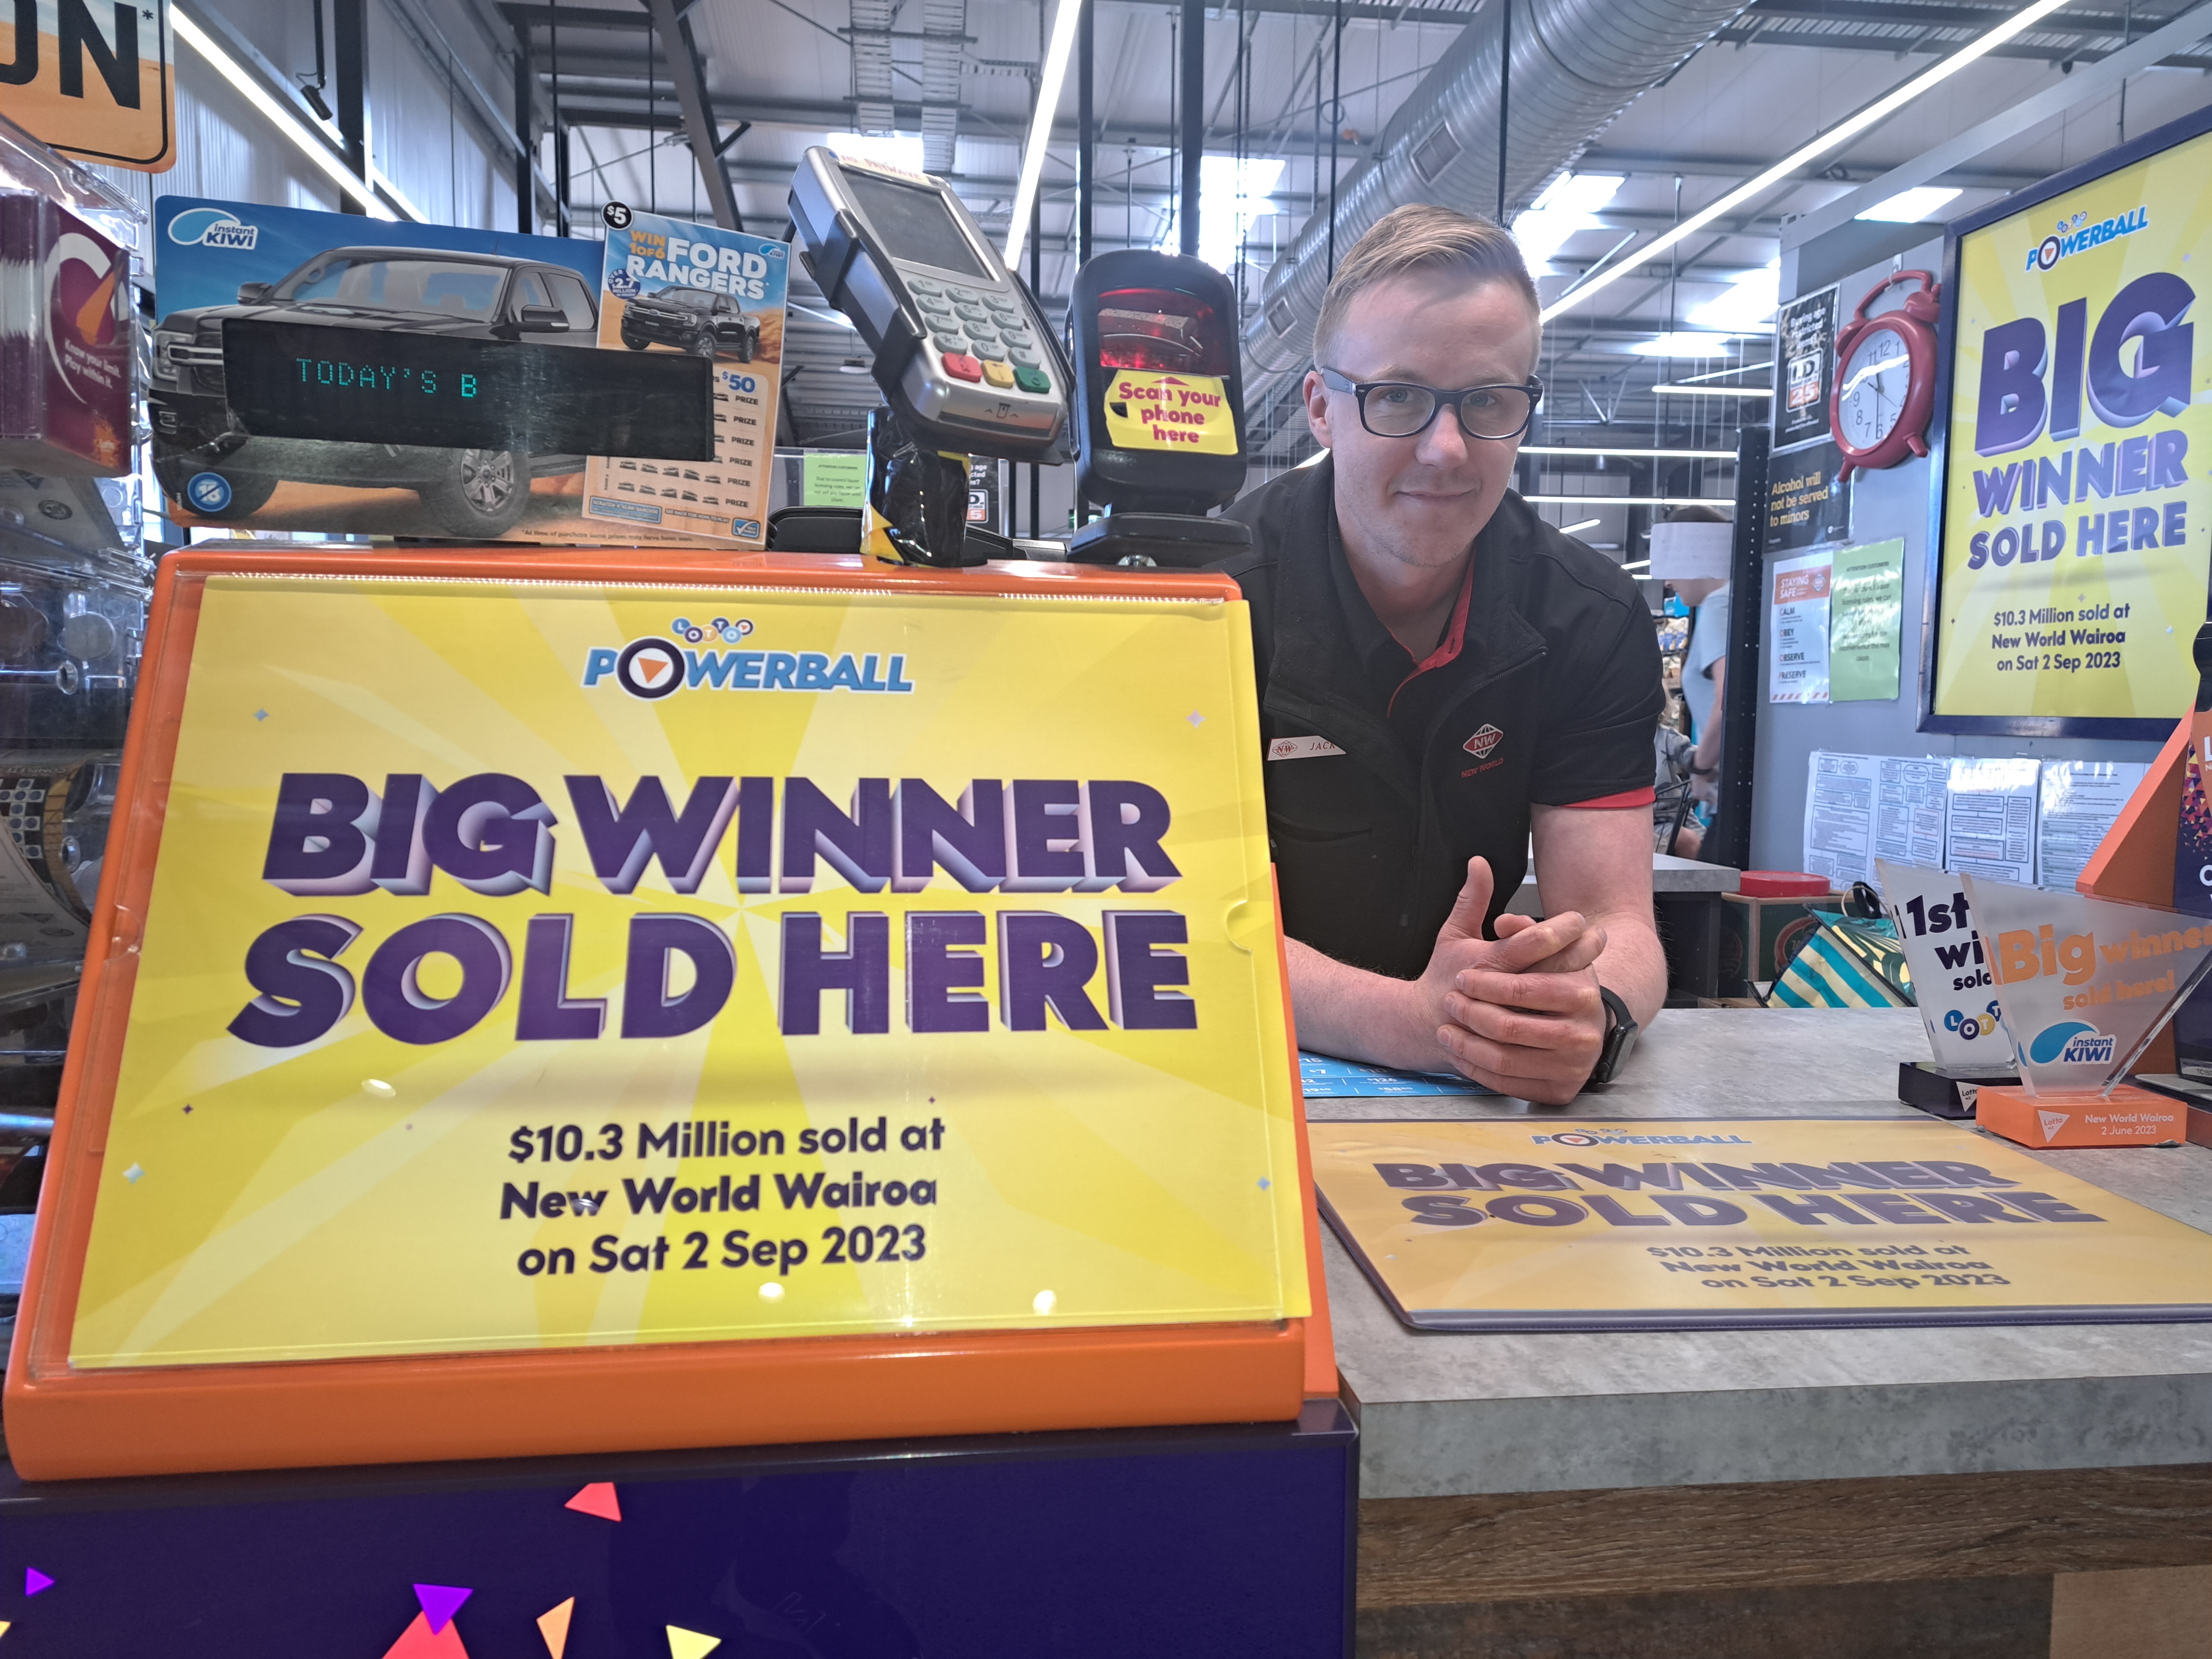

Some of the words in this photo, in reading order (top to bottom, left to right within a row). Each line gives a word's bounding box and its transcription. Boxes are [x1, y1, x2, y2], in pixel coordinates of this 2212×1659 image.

[607, 205, 627, 224] $5
[214, 223, 254, 235] instant
[2025, 205, 2149, 271] POWERBALL
[206, 232, 253, 247] KIWI
[630, 230, 666, 247] WIN
[667, 237, 767, 279] FORD
[65, 338, 85, 358] Know
[86, 353, 102, 368] your
[1879, 340, 1891, 357] 12
[1895, 341, 1900, 356] 1
[1975, 272, 2197, 457] BIG
[296, 357, 437, 394] TODAY'S
[461, 374, 476, 398] B
[722, 371, 755, 393] $50
[735, 395, 758, 405] PRIZE
[1119, 382, 1172, 401] Scan
[1179, 389, 1221, 408] your
[1792, 383, 1816, 405] 25
[1853, 391, 1860, 407] 9
[733, 416, 756, 426] PRIZE
[1140, 406, 1205, 425] phone
[1856, 409, 1863, 425] 8
[1153, 425, 1200, 443] here
[1865, 421, 1871, 438] 7
[731, 436, 754, 446] PRIZE
[730, 457, 752, 467] PRIZE
[727, 477, 751, 487] PRIZE
[1972, 429, 2190, 518] WINNER
[1771, 475, 1804, 496] Alcohol
[1806, 471, 1821, 487] will
[725, 498, 749, 508] PRIZE
[1770, 496, 1785, 512] not
[1786, 494, 1797, 508] be
[1799, 486, 1829, 505] served
[1770, 515, 1779, 527] to
[1780, 510, 1810, 525] minors
[1967, 520, 2067, 570] SOLD
[2076, 500, 2188, 557] HERE
[1780, 587, 1797, 598] SAFE
[1780, 607, 1795, 617] CALM
[1993, 609, 2026, 626] $10.3
[2029, 606, 2074, 625] Million
[2078, 603, 2110, 621] sold
[2113, 603, 2131, 619] at
[674, 618, 740, 641] LOTTO
[1780, 628, 1794, 637] OBEY
[1991, 633, 2021, 649] New
[2024, 630, 2066, 647] World
[2069, 628, 2126, 644] Wairoa
[1779, 652, 1805, 662] OBSERVE
[1997, 658, 2013, 671] on
[2016, 654, 2039, 671] Sat
[2042, 654, 2051, 670] 2
[2053, 653, 2081, 673] Sep
[2085, 652, 2121, 669] 2023
[583, 638, 913, 699] POWERBALL
[1309, 741, 1335, 751] JACK
[1474, 734, 1497, 750] NW
[1461, 768, 1479, 778] NEW
[1479, 758, 1504, 774] WORLD
[261, 772, 559, 897] BIG
[564, 774, 1183, 896] WINNER
[1907, 892, 1970, 936] 1st
[1998, 923, 2097, 986] Big
[226, 911, 737, 1049] SOLD
[778, 909, 1198, 1038] HERE
[2063, 980, 2111, 1010] sold
[2117, 970, 2176, 1002] here!
[1945, 1001, 2001, 1039] LOTT
[2073, 1037, 2113, 1048] instant
[2063, 1047, 2112, 1062] KIWI
[2044, 1118, 2063, 1126] Lotto
[2084, 1114, 2106, 1123] New
[2109, 1114, 2137, 1123] World
[2139, 1113, 2174, 1122] Wairoa
[2101, 1127, 2107, 1135] 2
[2109, 1126, 2133, 1135] June
[2135, 1125, 2157, 1134] 2023
[509, 1124, 624, 1163] $10.3
[637, 1120, 785, 1160] Million
[797, 1116, 887, 1154] sold
[900, 1117, 945, 1151] at
[1531, 1132, 1752, 1147] POWERBALL
[1371, 1161, 1583, 1191] BIG
[1565, 1161, 2021, 1191] WINNER
[500, 1181, 608, 1219] New
[622, 1174, 760, 1215] World
[773, 1171, 938, 1210] Wairoa
[1402, 1194, 1746, 1227] SOLD
[1753, 1192, 2108, 1225] HERE
[517, 1247, 574, 1276] on
[588, 1234, 670, 1273] Sat
[682, 1231, 709, 1270] 2
[721, 1229, 808, 1276] Sep
[821, 1224, 926, 1264] 2023
[1646, 1246, 1734, 1258] $10.3
[1735, 1246, 1853, 1257] Million
[1862, 1245, 1930, 1256] sold
[1934, 1245, 1971, 1255] at
[1659, 1261, 1742, 1272] New
[1745, 1260, 1860, 1272] World
[1858, 1259, 1994, 1270] Wairoa
[1701, 1277, 1749, 1288] on
[1755, 1276, 1816, 1288] Sat
[1818, 1275, 1848, 1287] 2
[1846, 1274, 1921, 1289] Sep
[1921, 1273, 2012, 1286] 2023
